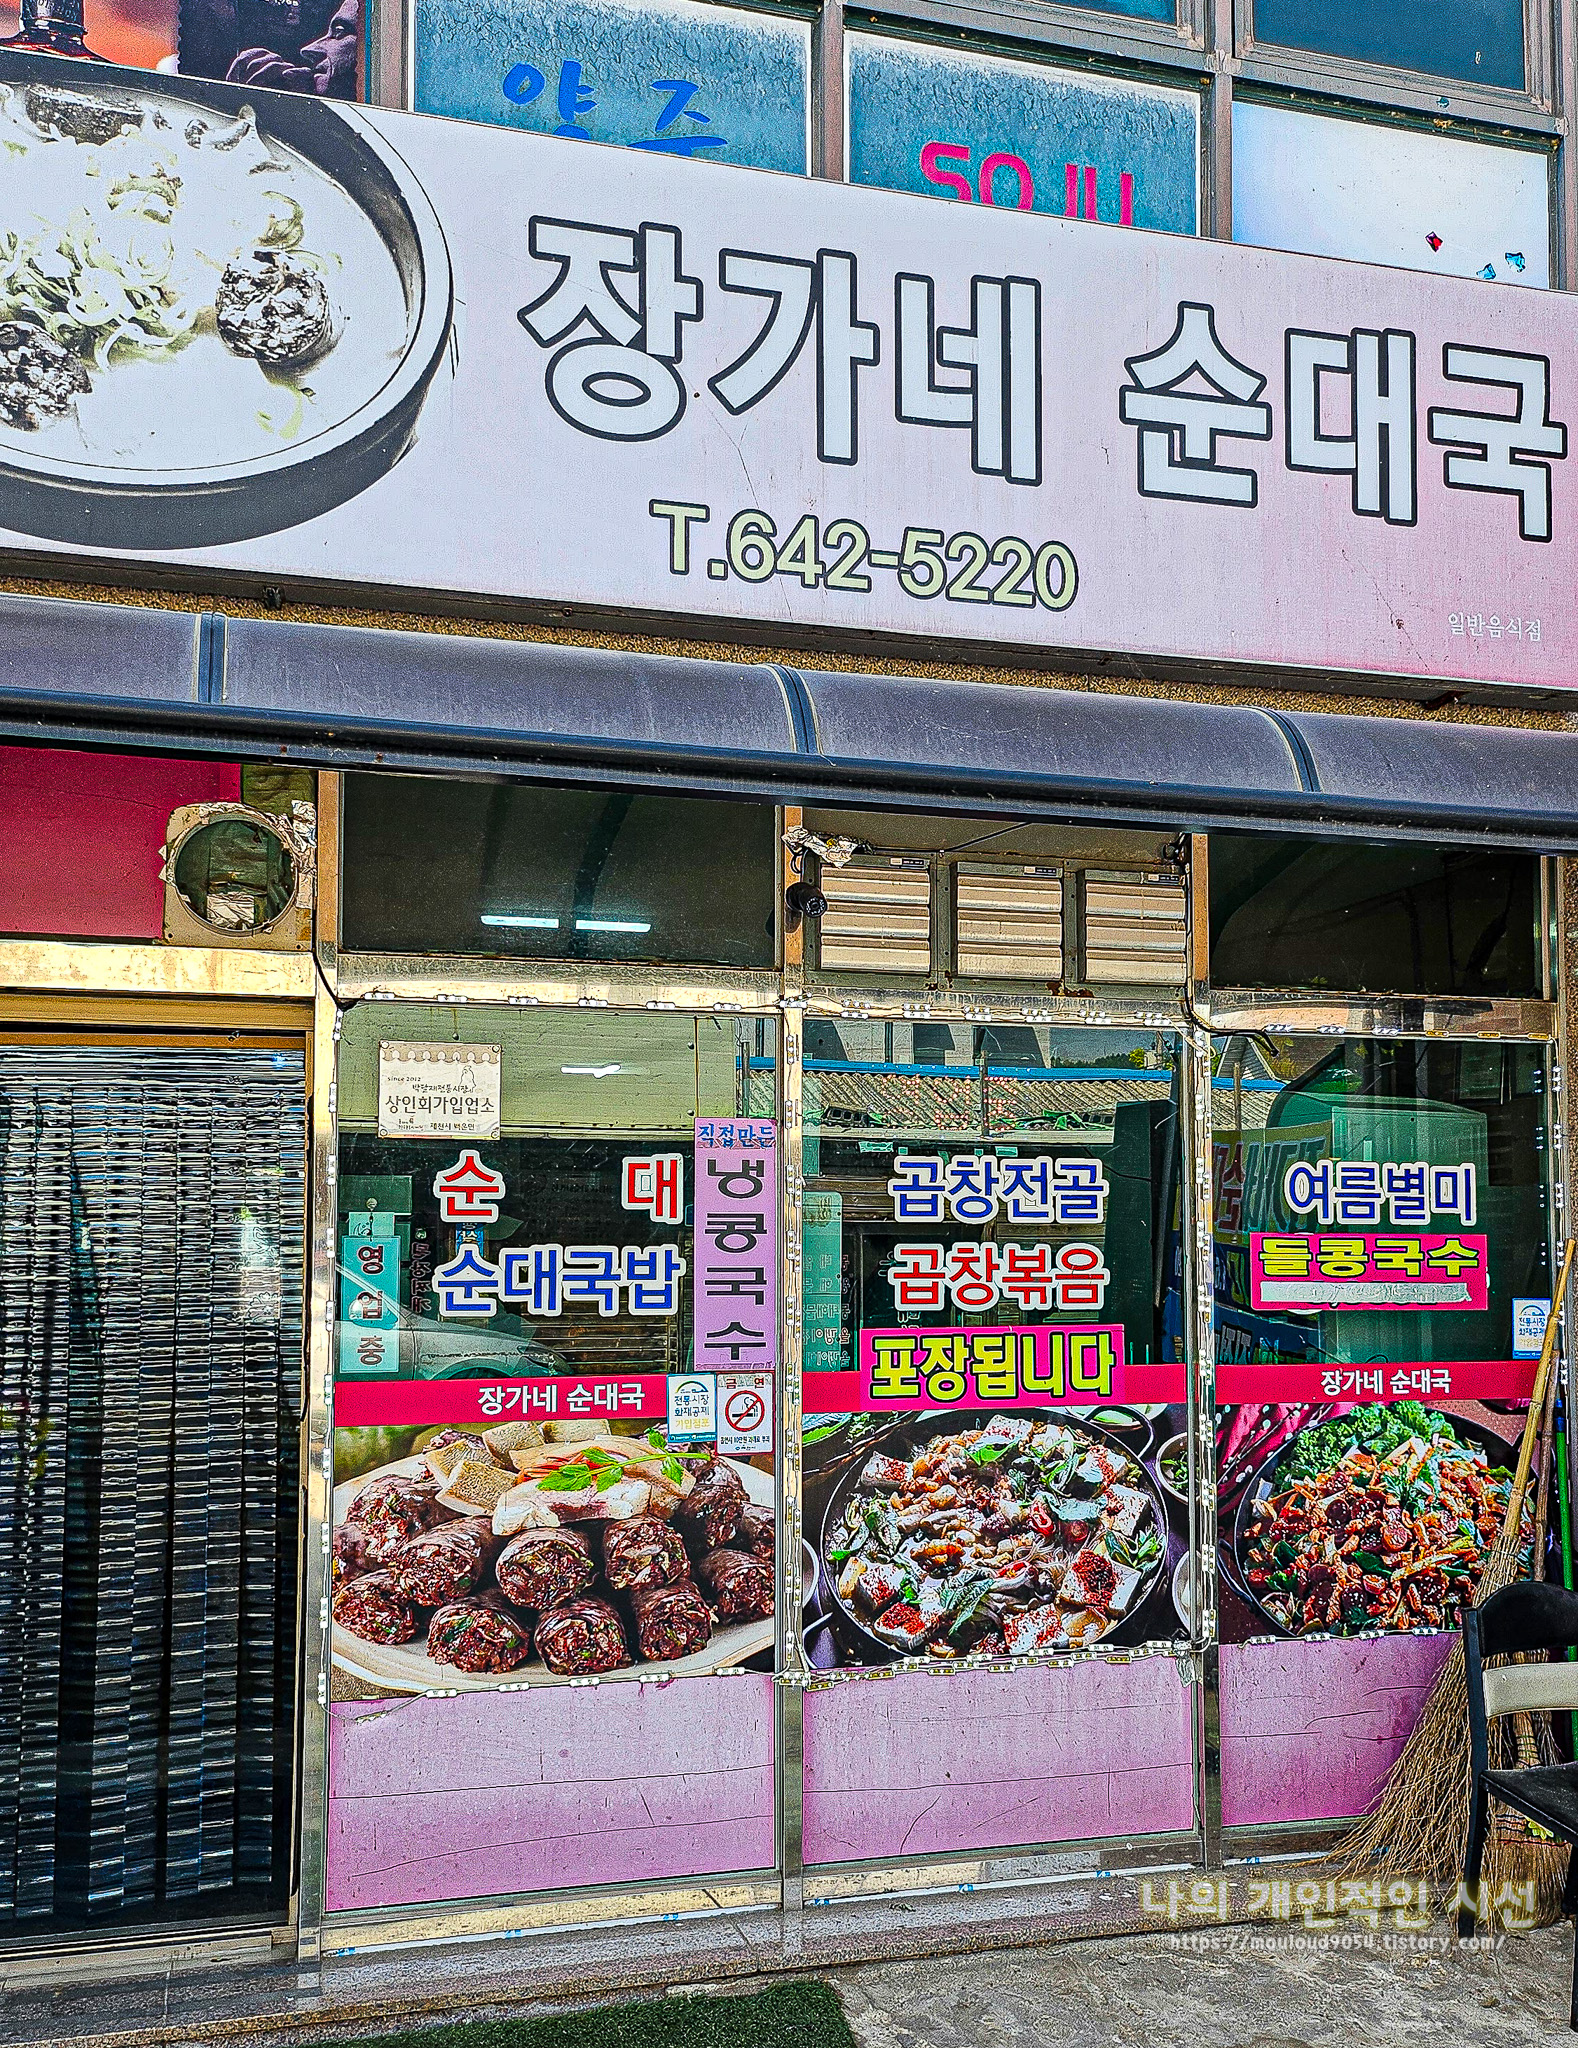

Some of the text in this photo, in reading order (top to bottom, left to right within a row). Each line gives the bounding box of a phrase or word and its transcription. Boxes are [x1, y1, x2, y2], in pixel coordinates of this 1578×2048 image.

[517, 215, 1567, 542] 장가네 순대국
[649, 499, 1079, 611] T.642-5220
[1448, 612, 1541, 641] 일반음식점
[385, 1095, 495, 1115] 상인회가입업소
[697, 1122, 775, 1148] 직접만든
[889, 1158, 1107, 1221] 곱창전골
[1286, 1162, 1475, 1223] 여름별미
[434, 1247, 683, 1314] 순대국밥
[703, 1157, 768, 1361] 냉콩국수
[890, 1244, 1108, 1309] 곱창볶음
[1259, 1237, 1479, 1278] 들콩국수
[357, 1245, 385, 1365] 영업중
[870, 1332, 1116, 1400] 포장됩니다
[1320, 1367, 1452, 1395] 장가네 순대국
[478, 1382, 645, 1415] 장가네 순대국
[674, 1394, 709, 1406] 전통시장
[674, 1406, 710, 1417] 화재공제
